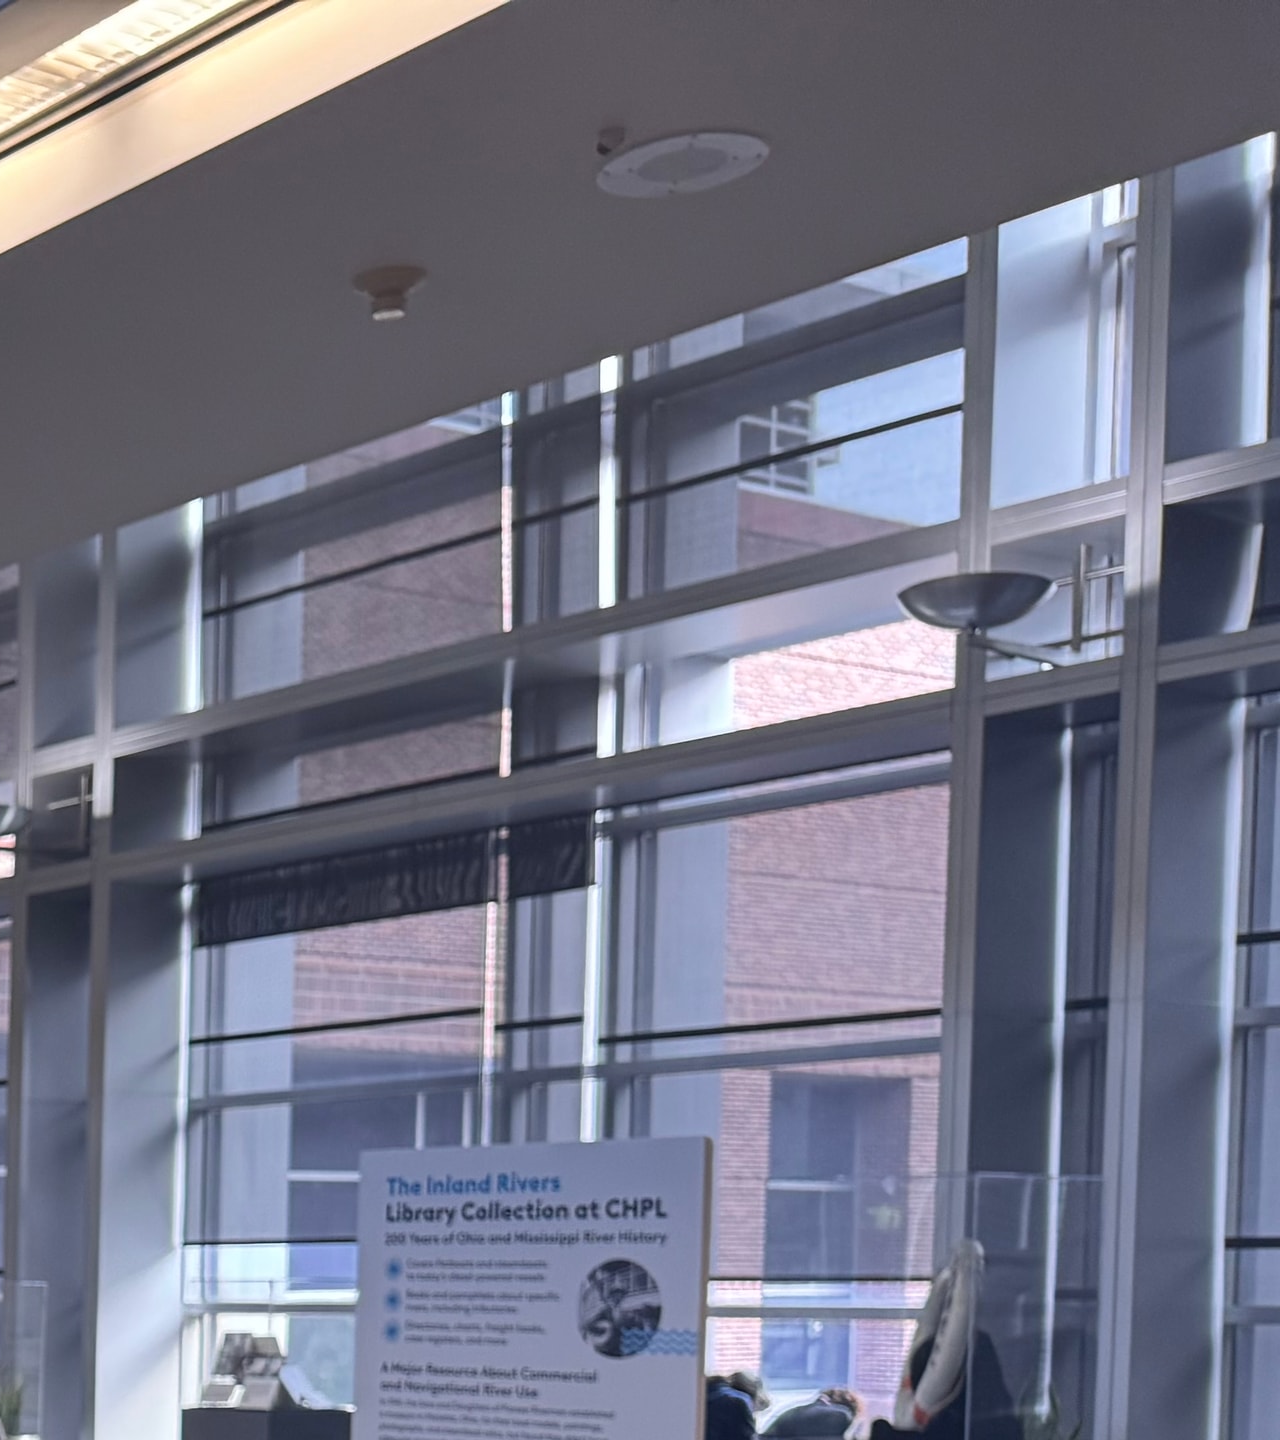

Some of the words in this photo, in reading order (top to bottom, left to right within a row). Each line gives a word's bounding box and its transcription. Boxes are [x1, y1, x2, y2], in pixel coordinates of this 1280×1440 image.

[386, 1176, 422, 1197] The
[426, 1173, 490, 1195] Inland
[496, 1171, 562, 1194] Rivers
[385, 1200, 455, 1227] Library
[460, 1198, 570, 1222] Collection
[574, 1200, 600, 1220] at
[604, 1196, 669, 1219] CHPL
[409, 1231, 439, 1246] Years
[440, 1230, 454, 1245] of
[456, 1230, 486, 1245] Ohio
[489, 1230, 512, 1244] and
[514, 1229, 580, 1247] Mississippi
[583, 1228, 616, 1243] River
[618, 1228, 668, 1246] History
[379, 1360, 389, 1374] A
[390, 1361, 423, 1377] Major
[425, 1362, 478, 1377] Resource
[480, 1365, 517, 1379] About
[520, 1366, 598, 1383] Commercial
[379, 1380, 402, 1392] and
[403, 1380, 480, 1398] Navigational
[482, 1384, 513, 1397] River
[515, 1385, 539, 1398] Use
